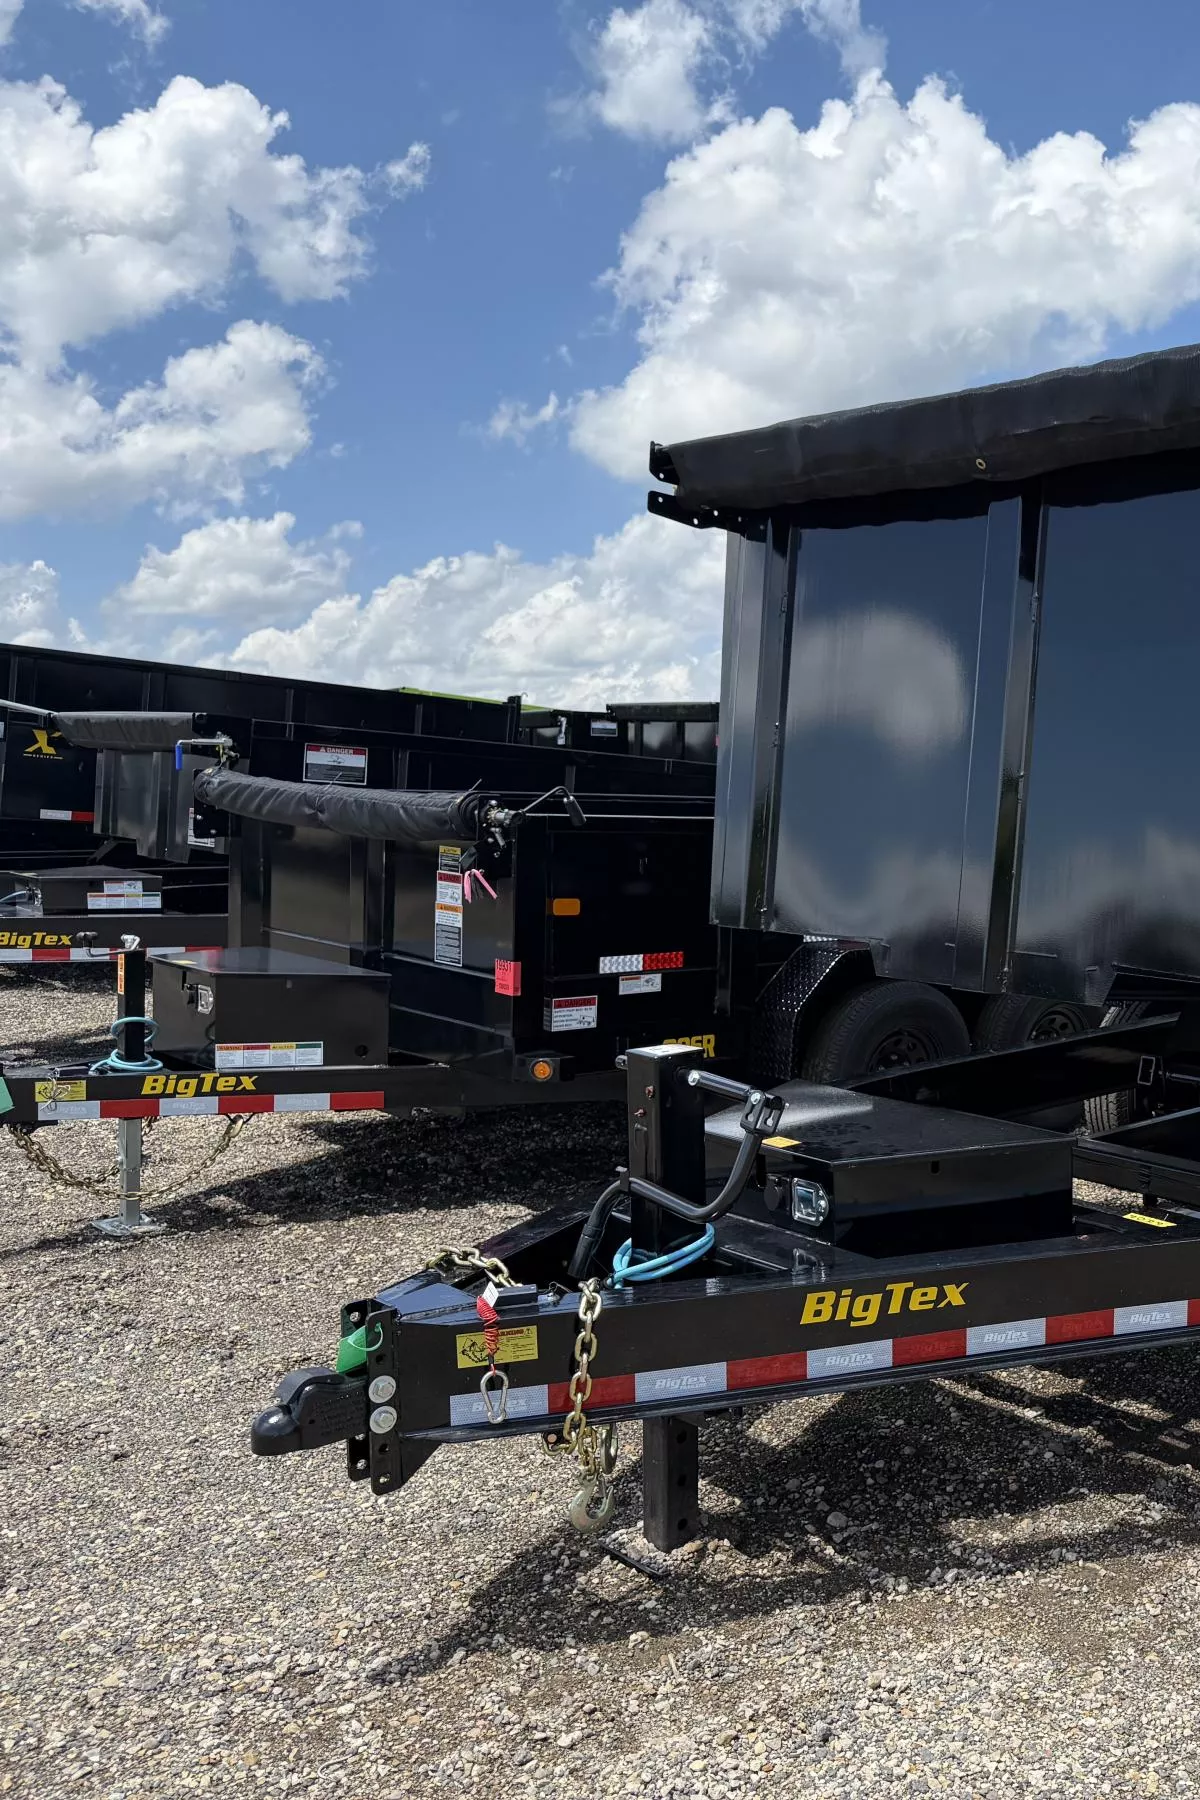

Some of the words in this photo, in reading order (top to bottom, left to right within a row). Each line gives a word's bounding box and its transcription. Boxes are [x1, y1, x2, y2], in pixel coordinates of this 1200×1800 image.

[0, 932, 73, 948] BigTex
[141, 1073, 258, 1098] BigTex
[800, 1281, 969, 1327] BigTex
[1130, 1312, 1171, 1324] BigTex
[984, 1330, 1029, 1343] BigTex
[826, 1353, 874, 1366] BigTex
[655, 1376, 707, 1389] BigTex
